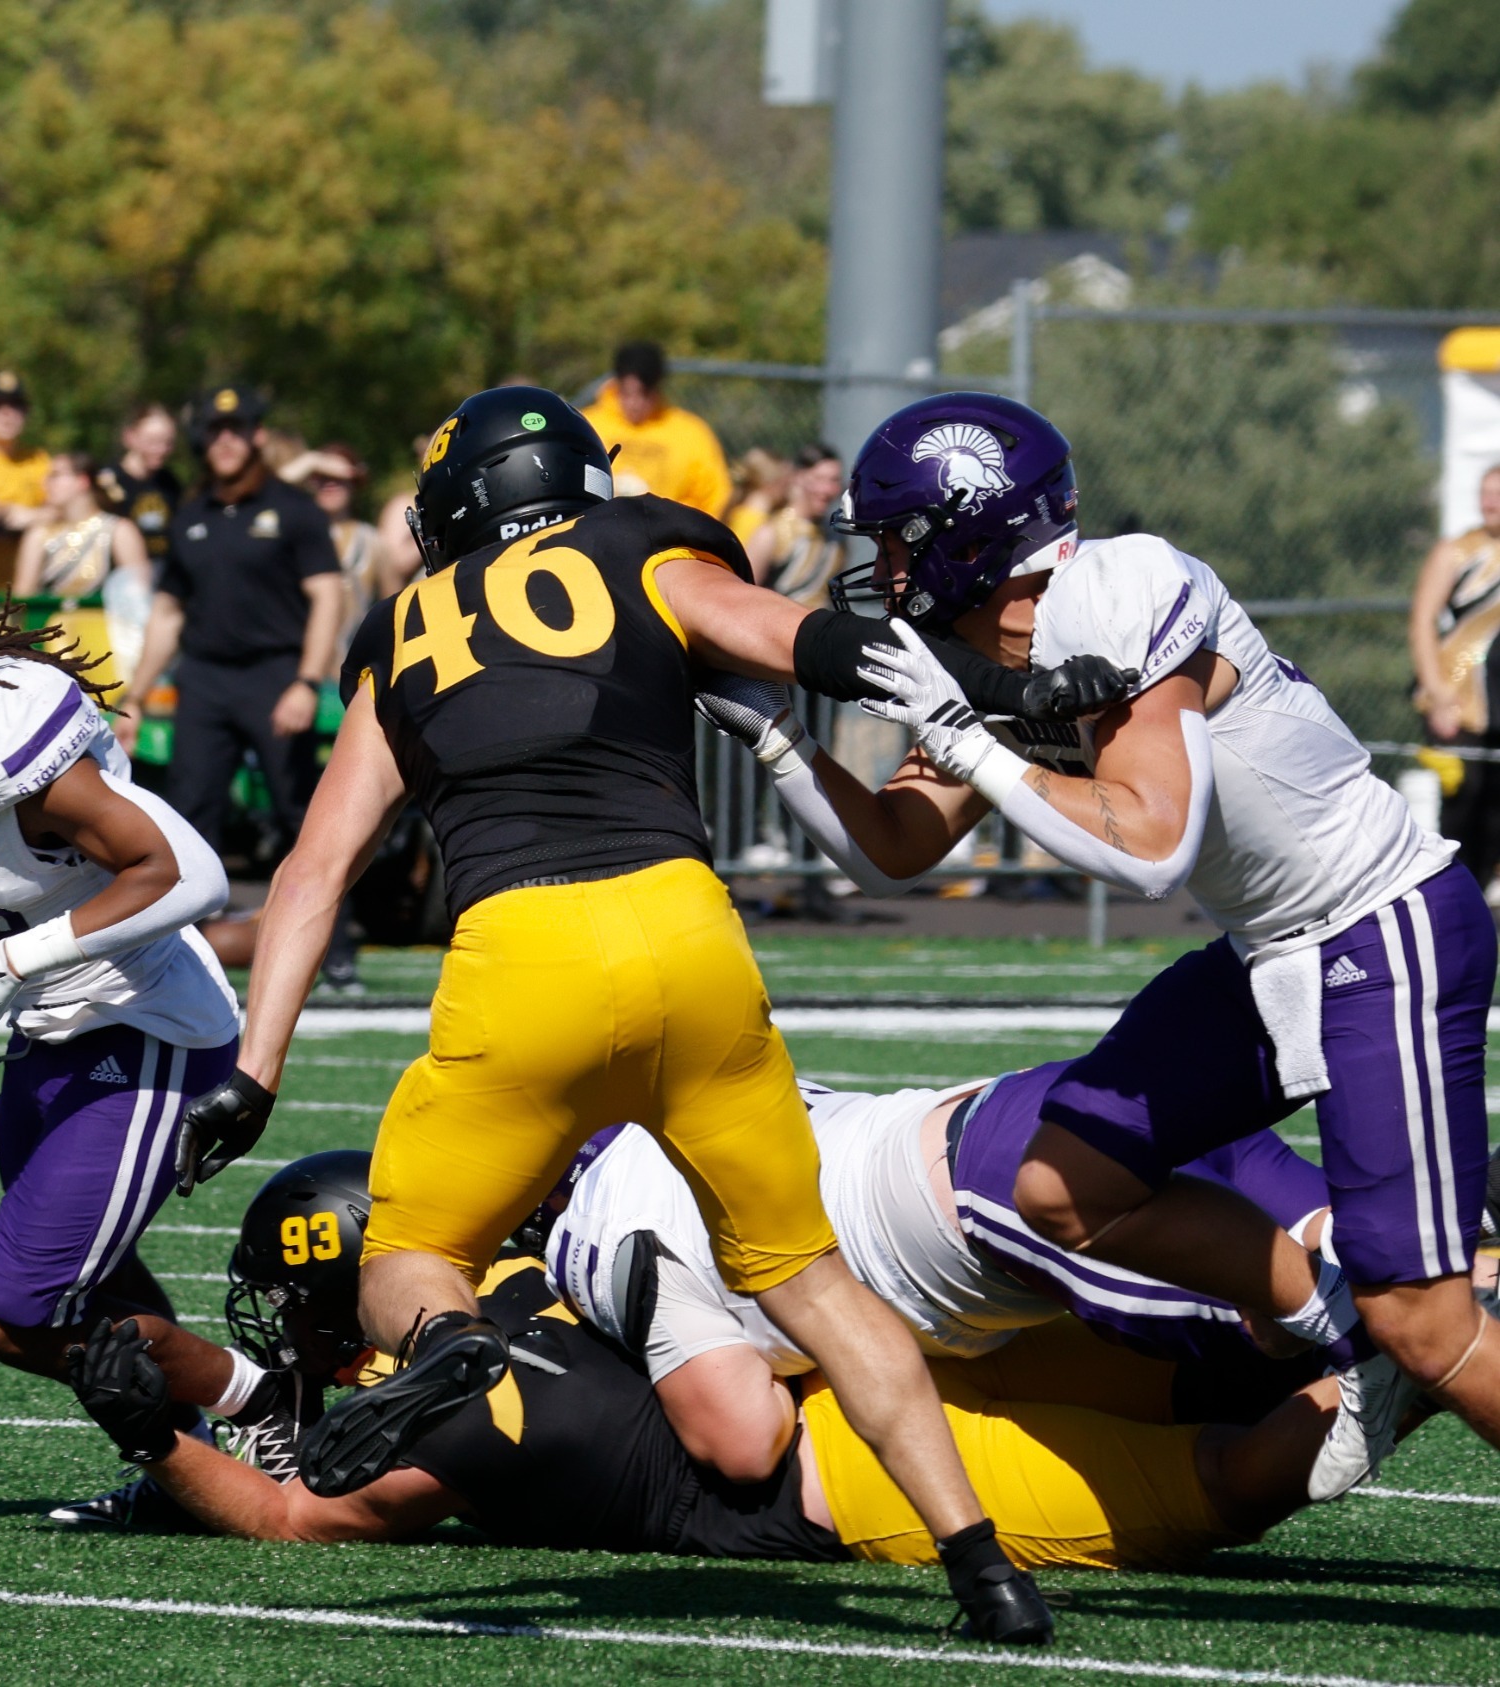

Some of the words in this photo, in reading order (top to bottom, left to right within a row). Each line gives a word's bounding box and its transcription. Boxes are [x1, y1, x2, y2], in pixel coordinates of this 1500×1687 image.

[523, 417, 544, 427] C2P
[390, 517, 616, 695] 46
[1324, 969, 1368, 988] adidas
[90, 1071, 128, 1084] adidas
[280, 1212, 342, 1266] 93
